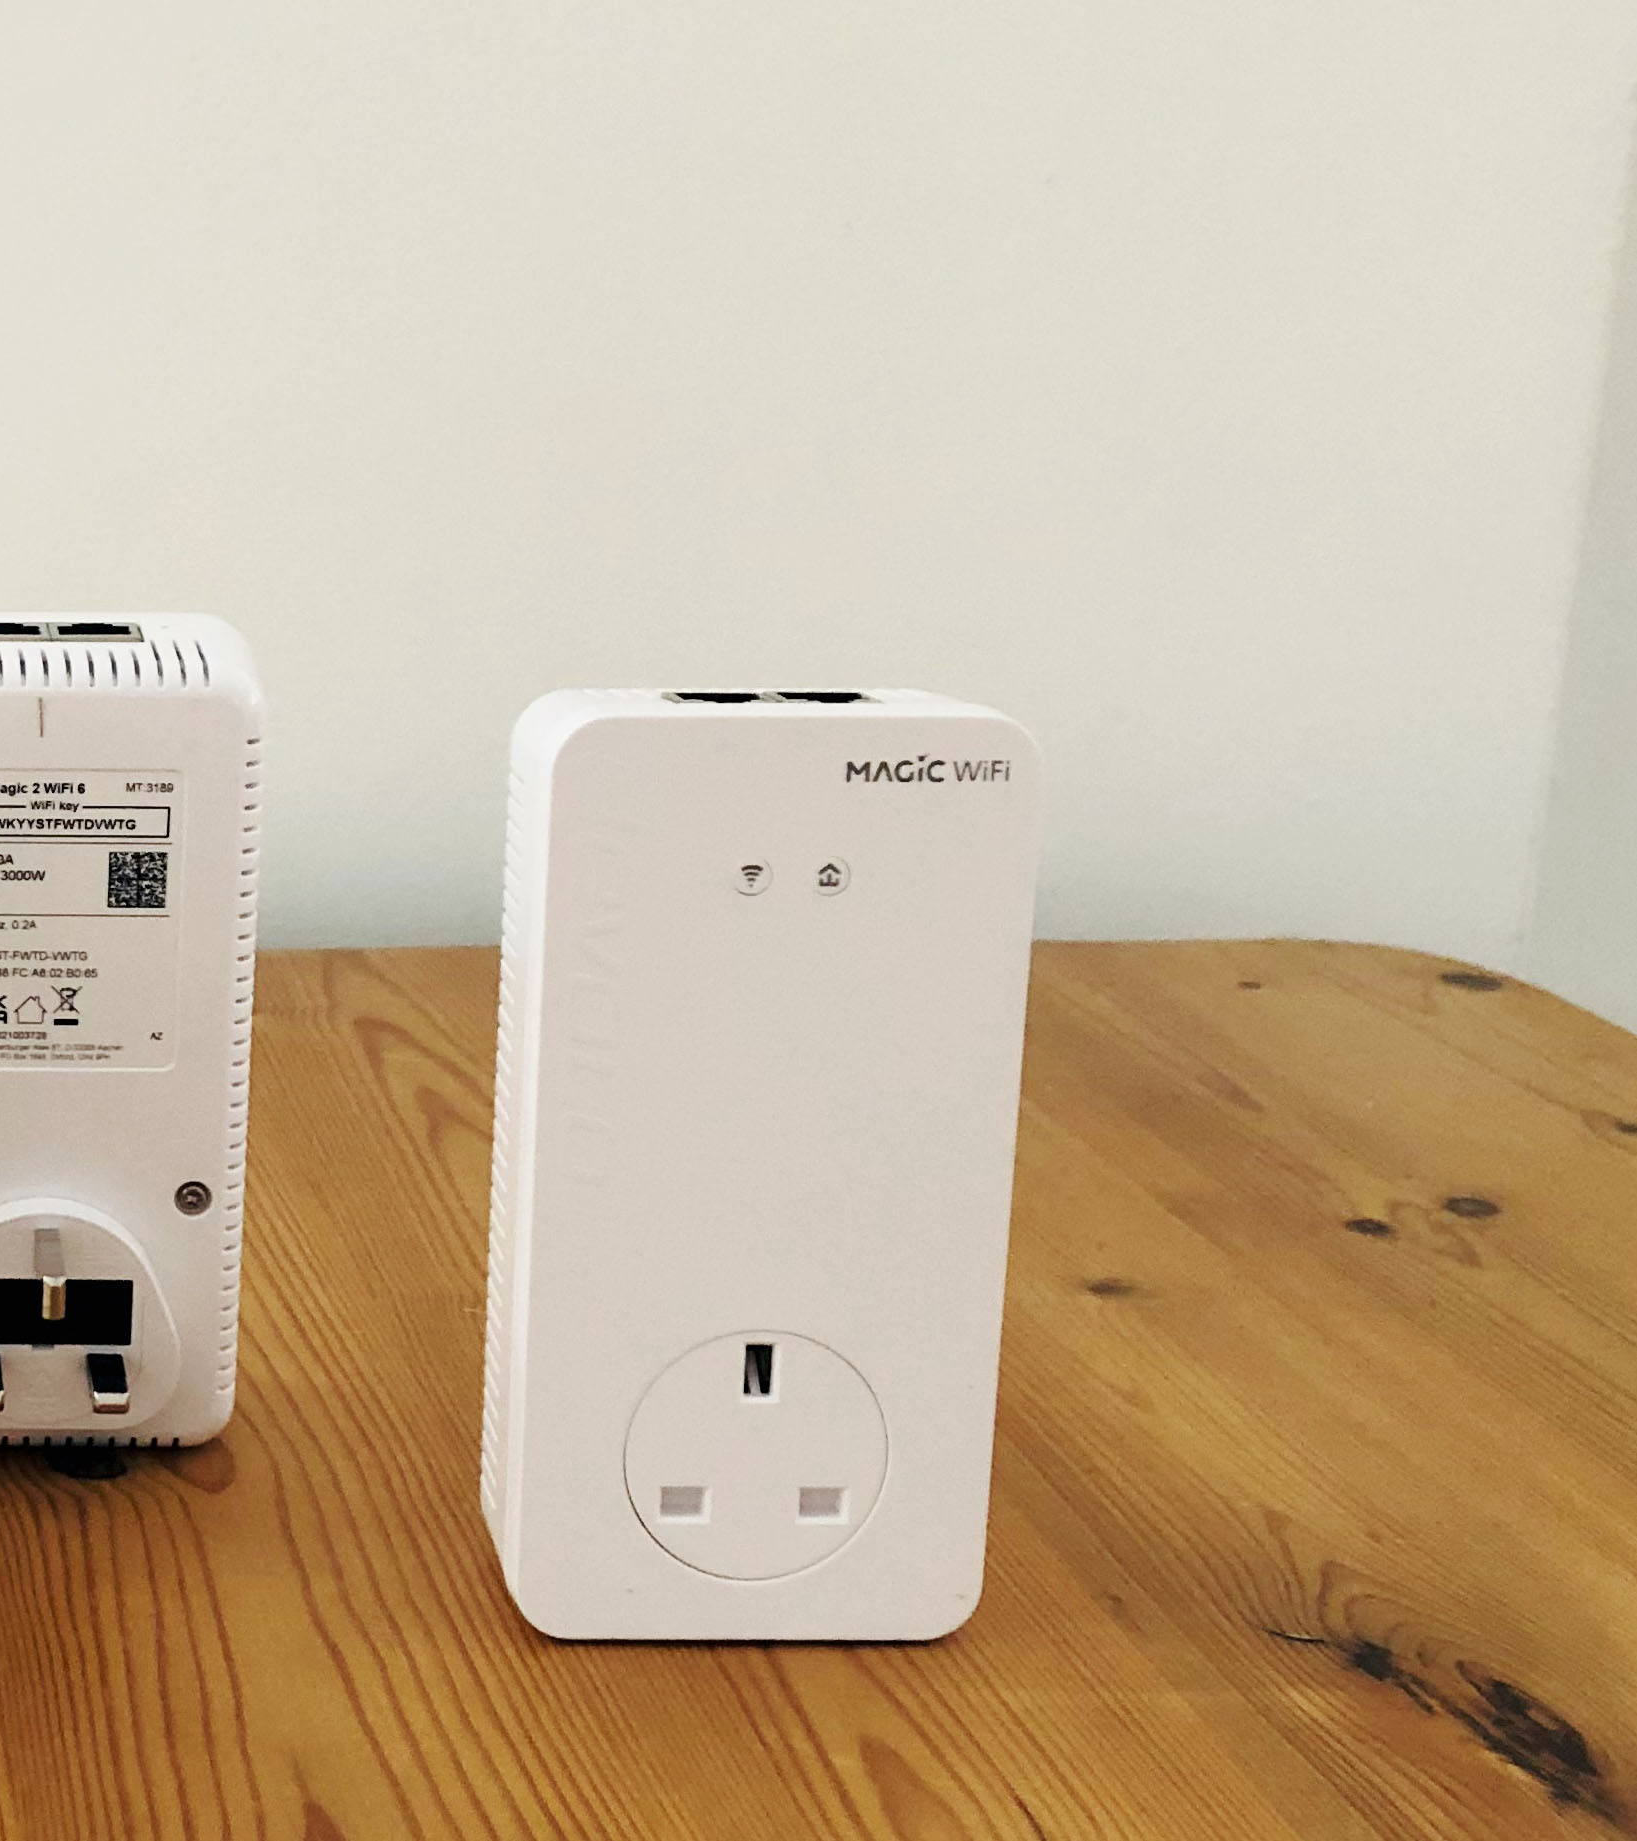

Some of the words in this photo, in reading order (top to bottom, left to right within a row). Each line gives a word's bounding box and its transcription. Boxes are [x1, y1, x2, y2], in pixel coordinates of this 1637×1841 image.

[953, 760, 1011, 782] WiFi
[32, 782, 41, 794] 2
[44, 783, 74, 794] WiFi
[77, 783, 86, 794] 6
[30, 801, 56, 811] WiFi
[59, 801, 80, 812] key
[1, 870, 46, 882] 3000W
